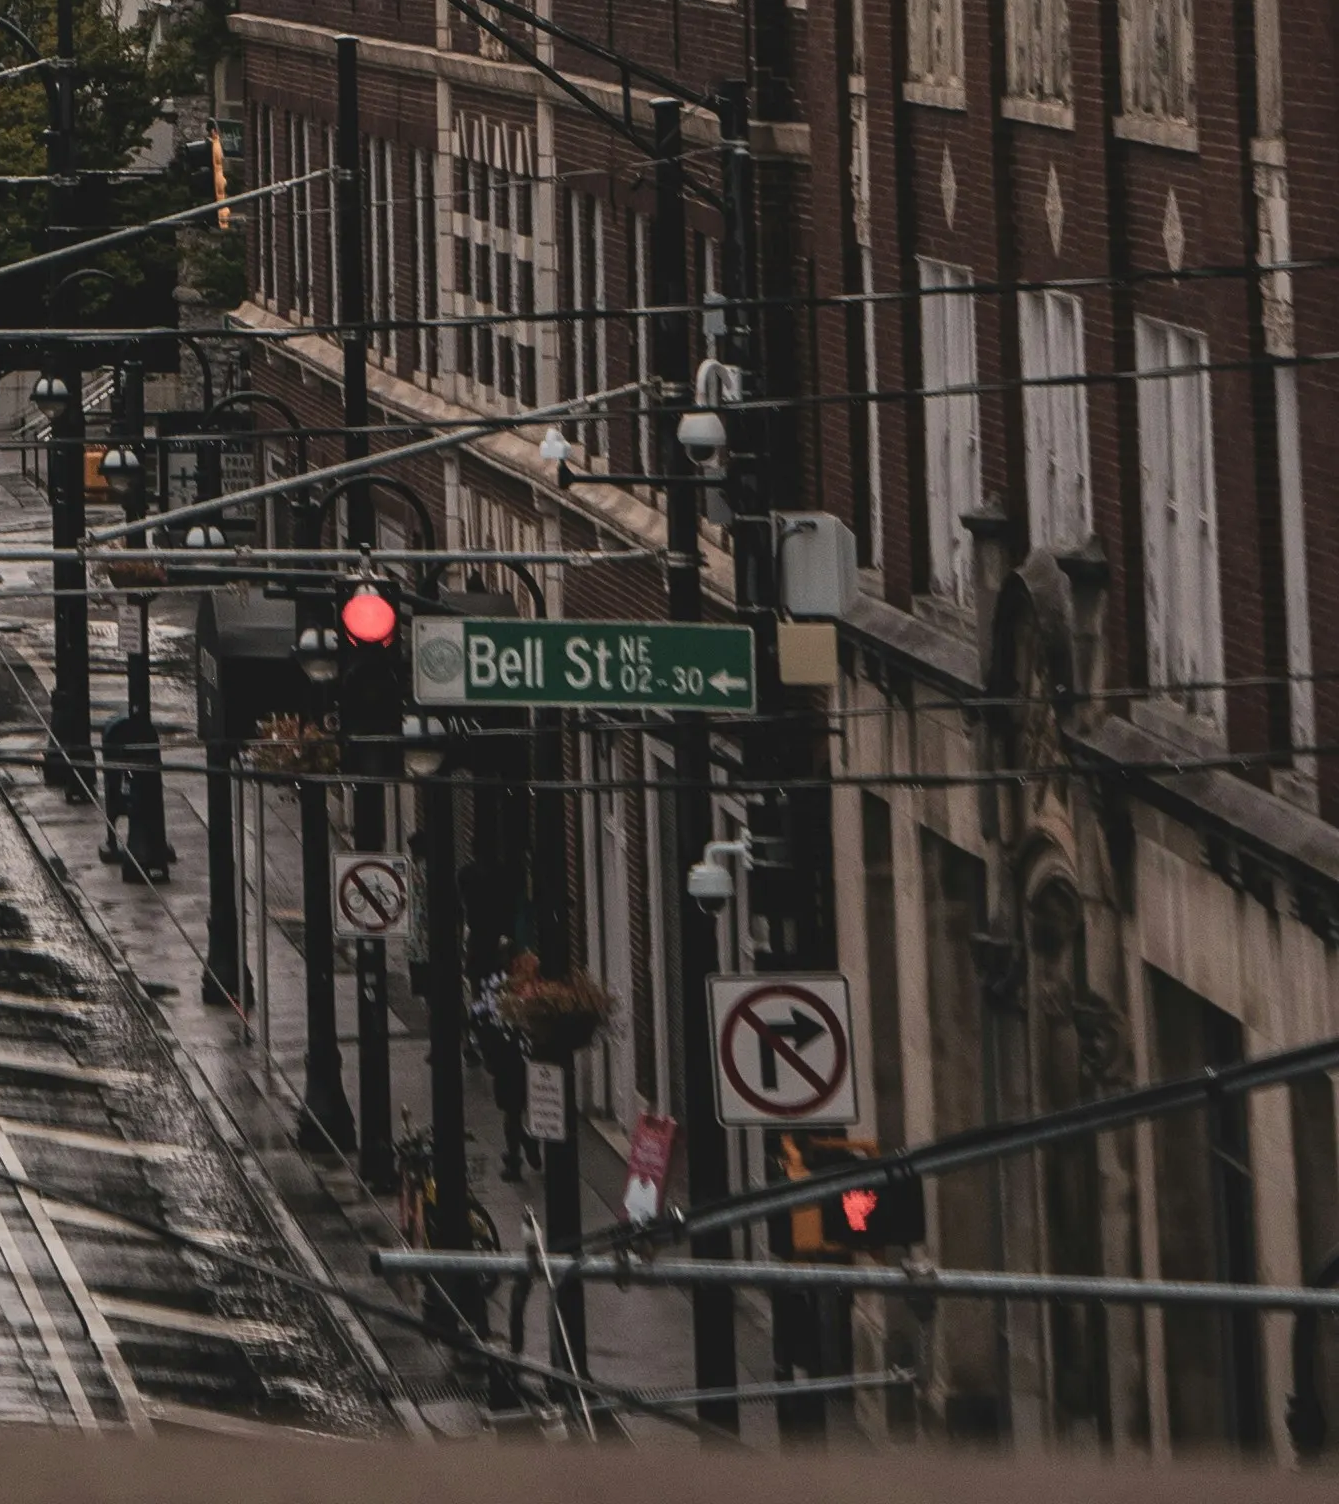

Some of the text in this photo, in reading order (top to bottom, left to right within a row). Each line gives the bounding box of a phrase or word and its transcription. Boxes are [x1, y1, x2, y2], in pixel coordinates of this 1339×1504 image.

[468, 635, 653, 691] Bell St NE
[620, 665, 705, 695] 02-30
